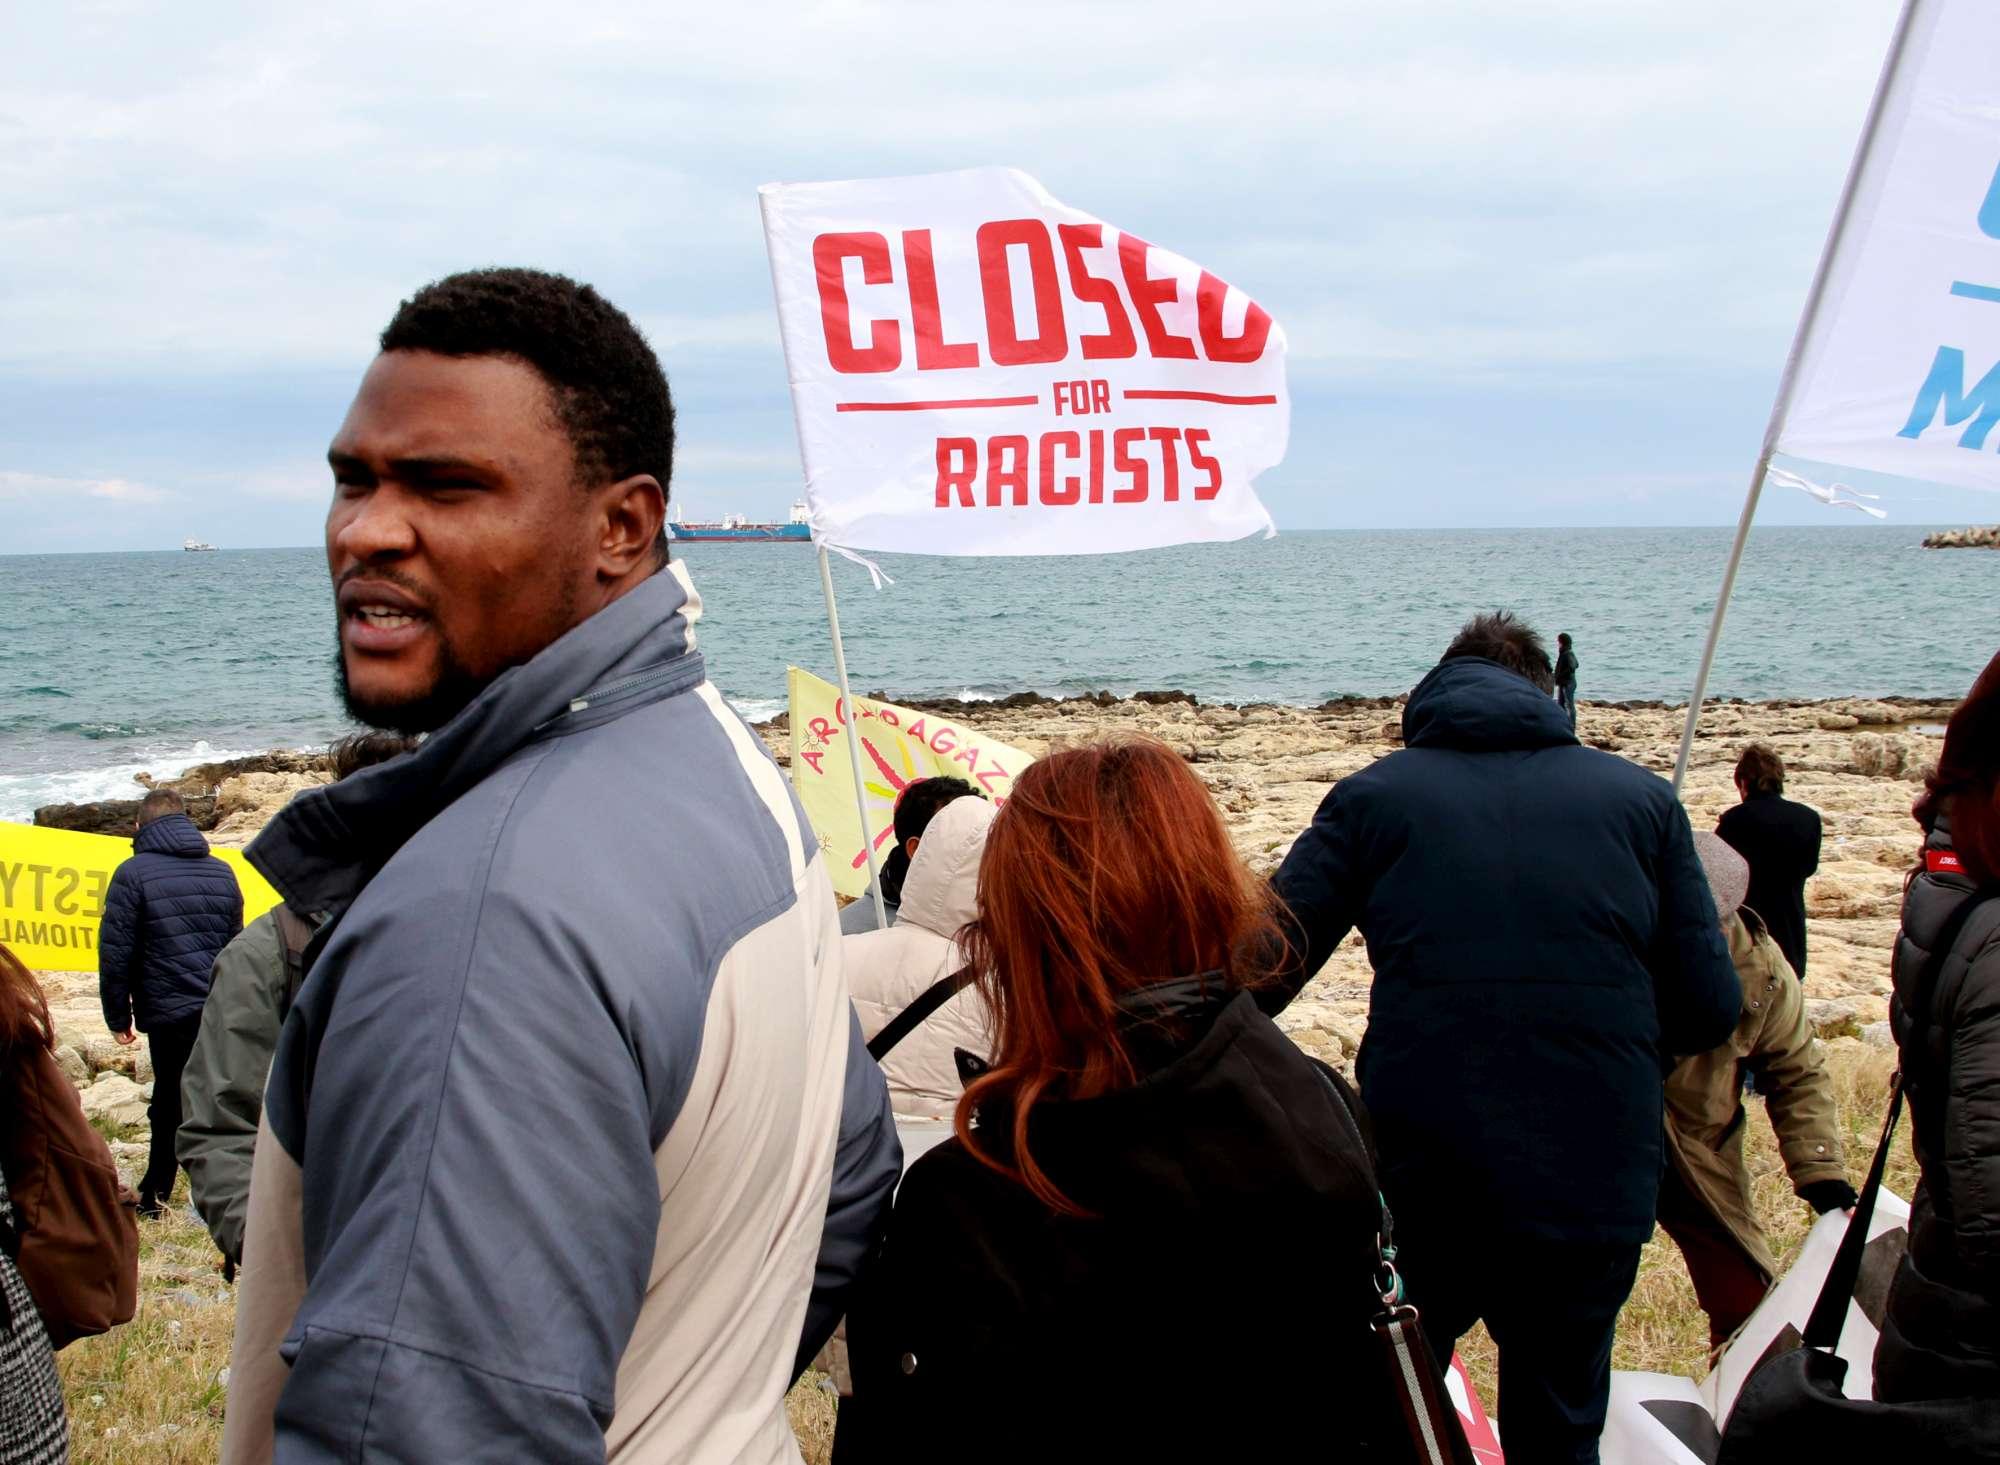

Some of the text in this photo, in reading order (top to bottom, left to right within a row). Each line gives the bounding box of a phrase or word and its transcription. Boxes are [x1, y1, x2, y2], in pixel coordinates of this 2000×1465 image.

[1053, 379, 1111, 416] FOR
[1895, 345, 2000, 454] M
[935, 427, 1221, 508] RACISTS
